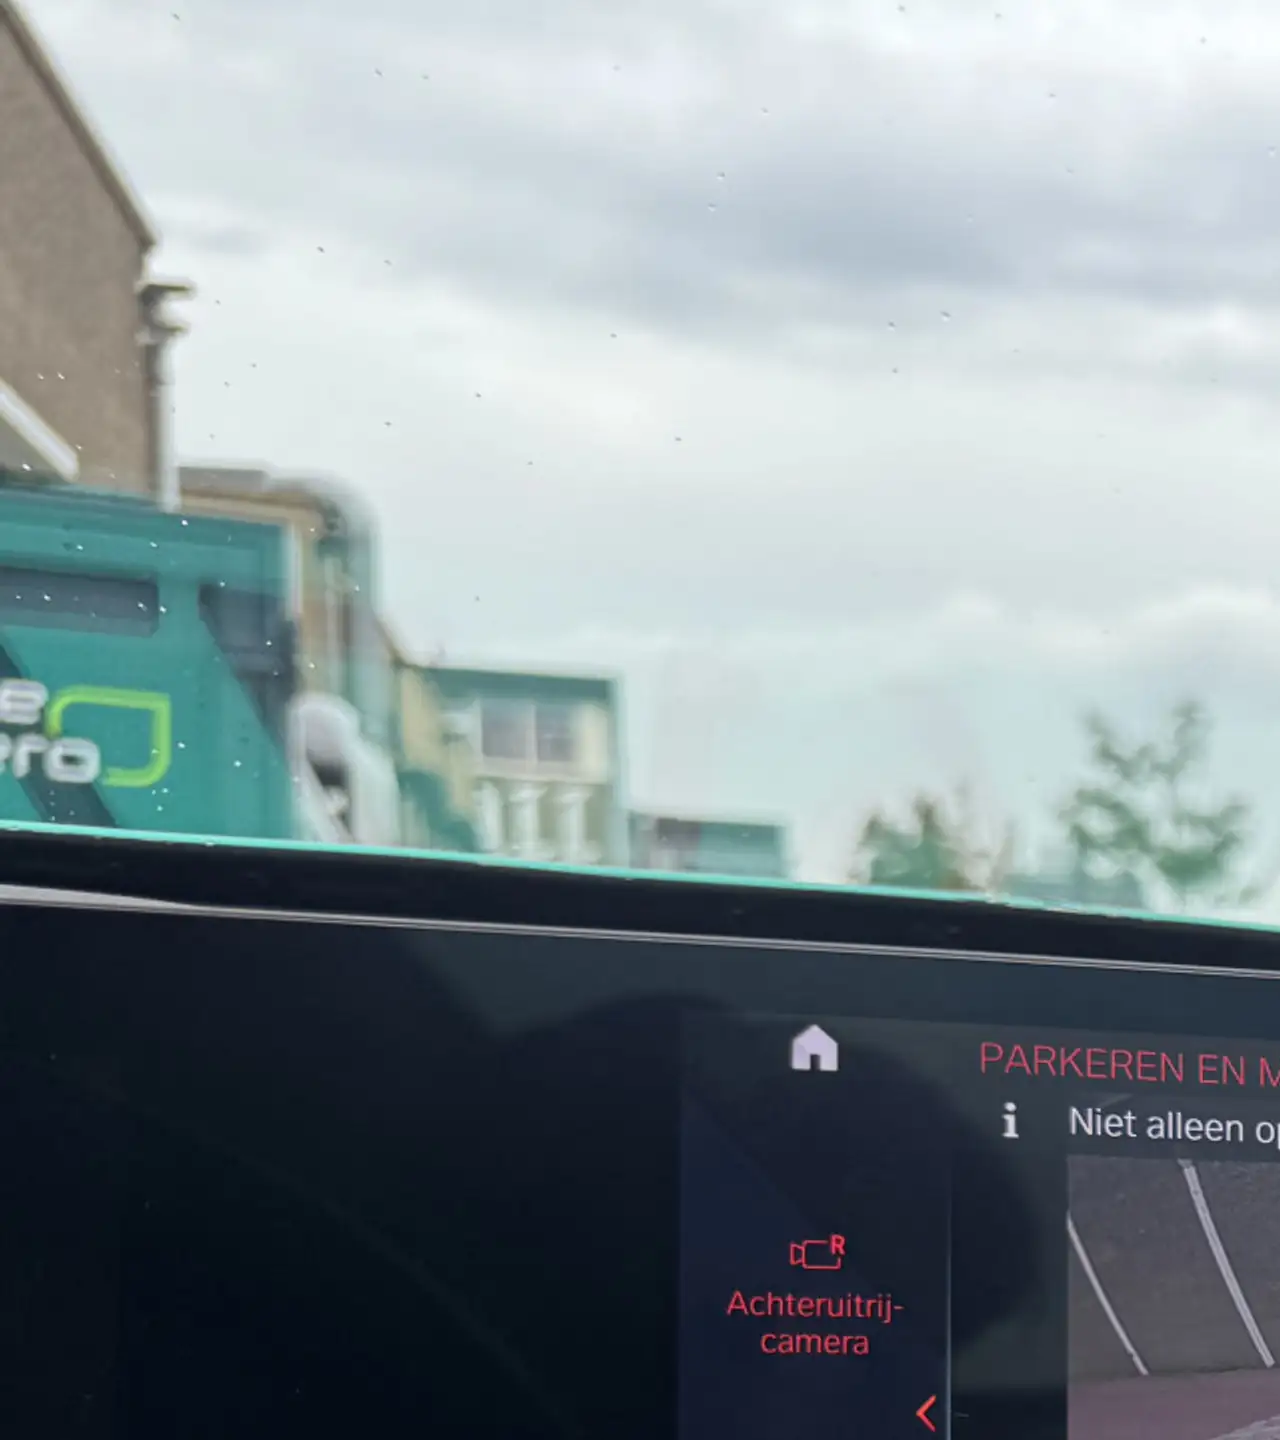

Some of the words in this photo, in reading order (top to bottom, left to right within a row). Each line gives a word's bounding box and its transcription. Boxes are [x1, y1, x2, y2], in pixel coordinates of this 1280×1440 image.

[0, 732, 100, 783] ro
[979, 1041, 1184, 1082] PARKEREN
[1198, 1053, 1246, 1086] EN
[1068, 1106, 1137, 1139] Niet
[1146, 1110, 1244, 1143] alleen
[726, 1289, 905, 1325] Achteruitrij-
[760, 1329, 870, 1356] camera
